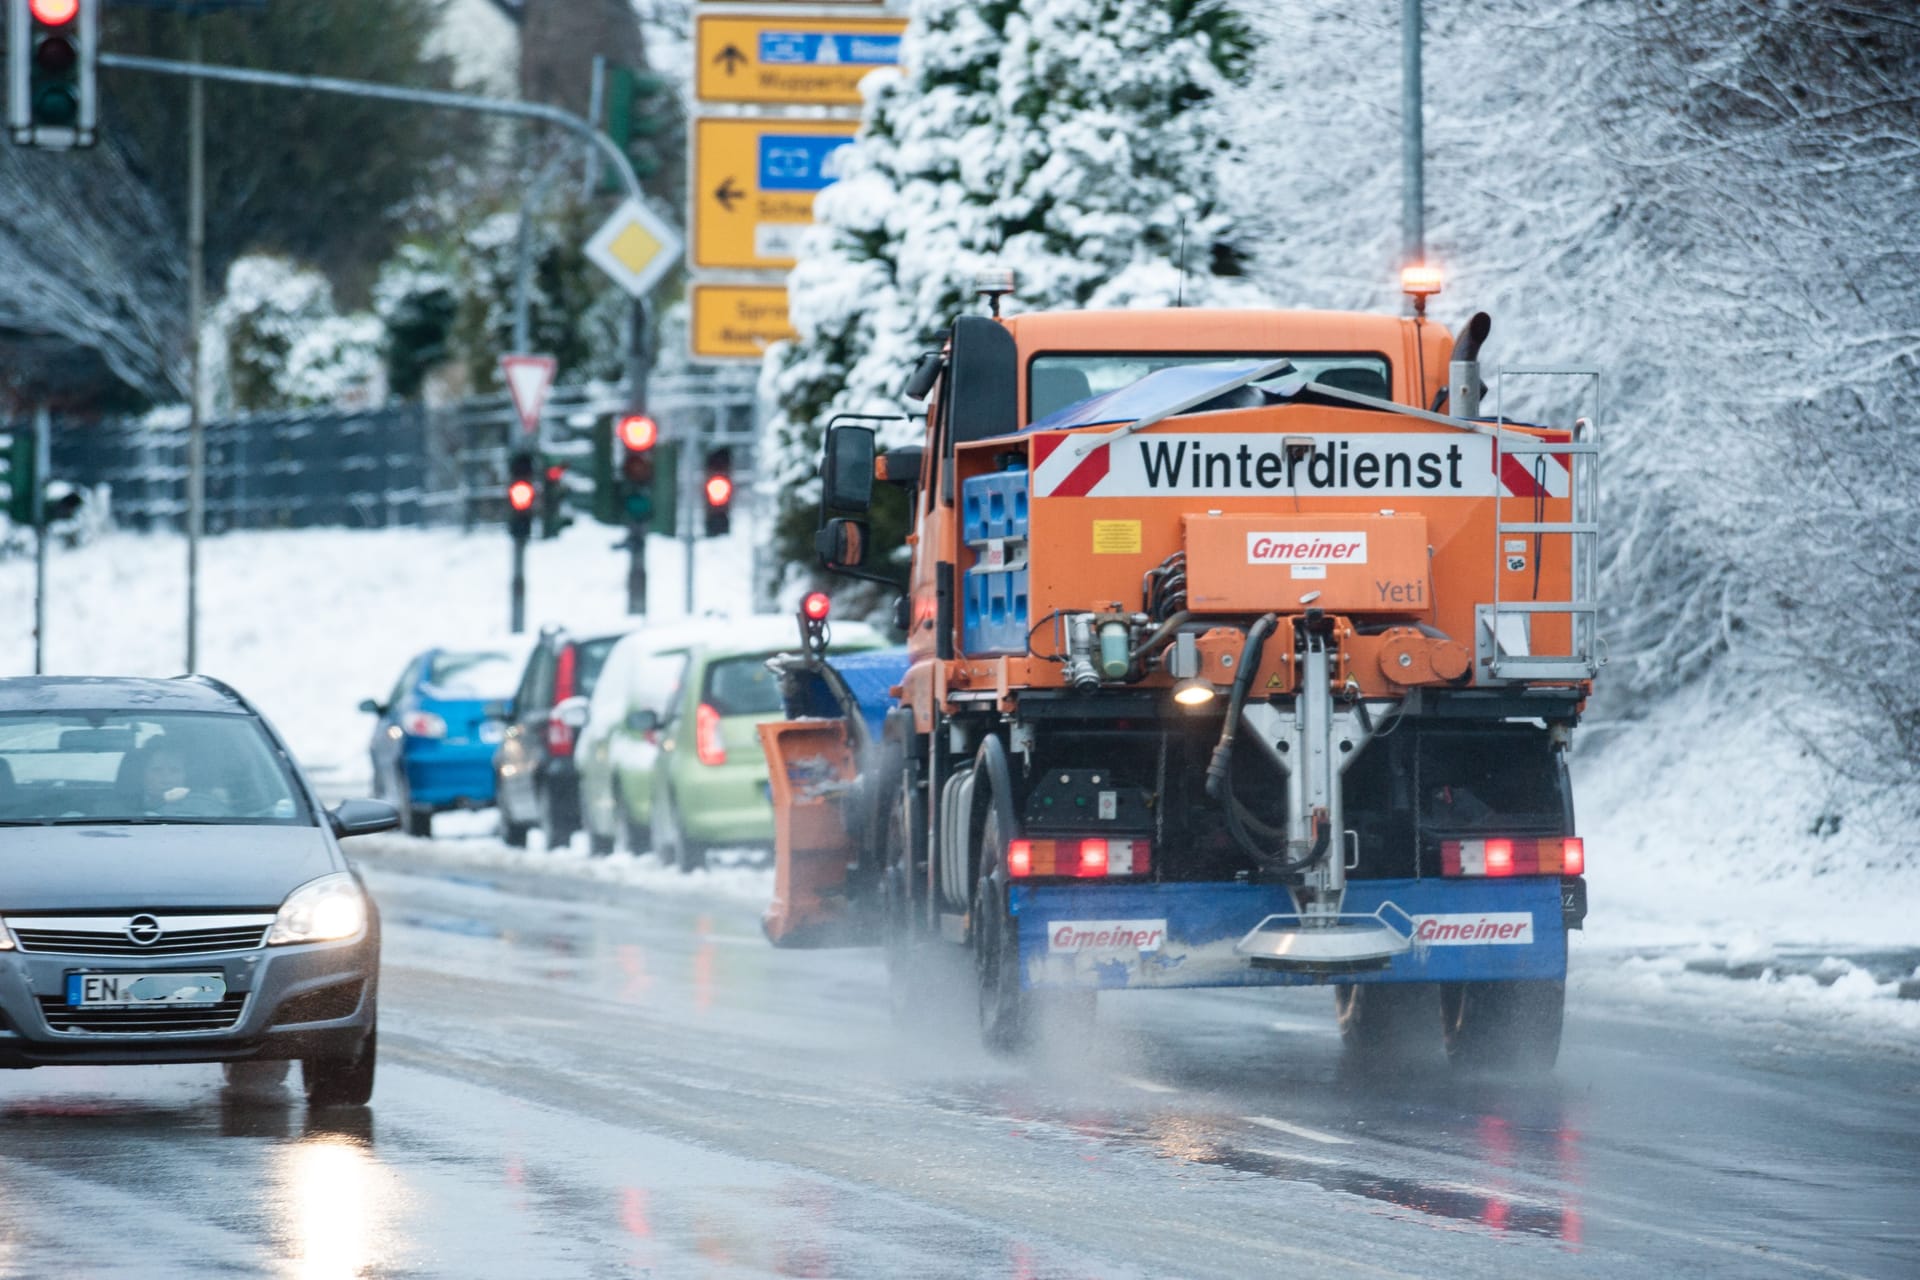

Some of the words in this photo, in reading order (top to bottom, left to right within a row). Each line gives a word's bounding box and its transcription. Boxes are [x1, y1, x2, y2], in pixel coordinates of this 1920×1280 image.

[1139, 440, 1462, 488] Winterdienst
[1252, 538, 1361, 559] Gmeiner
[1375, 580, 1422, 602] Yeti
[1053, 925, 1162, 948] Gmeiner
[1418, 918, 1528, 941] Gmeiner
[85, 978, 118, 1001] EN
